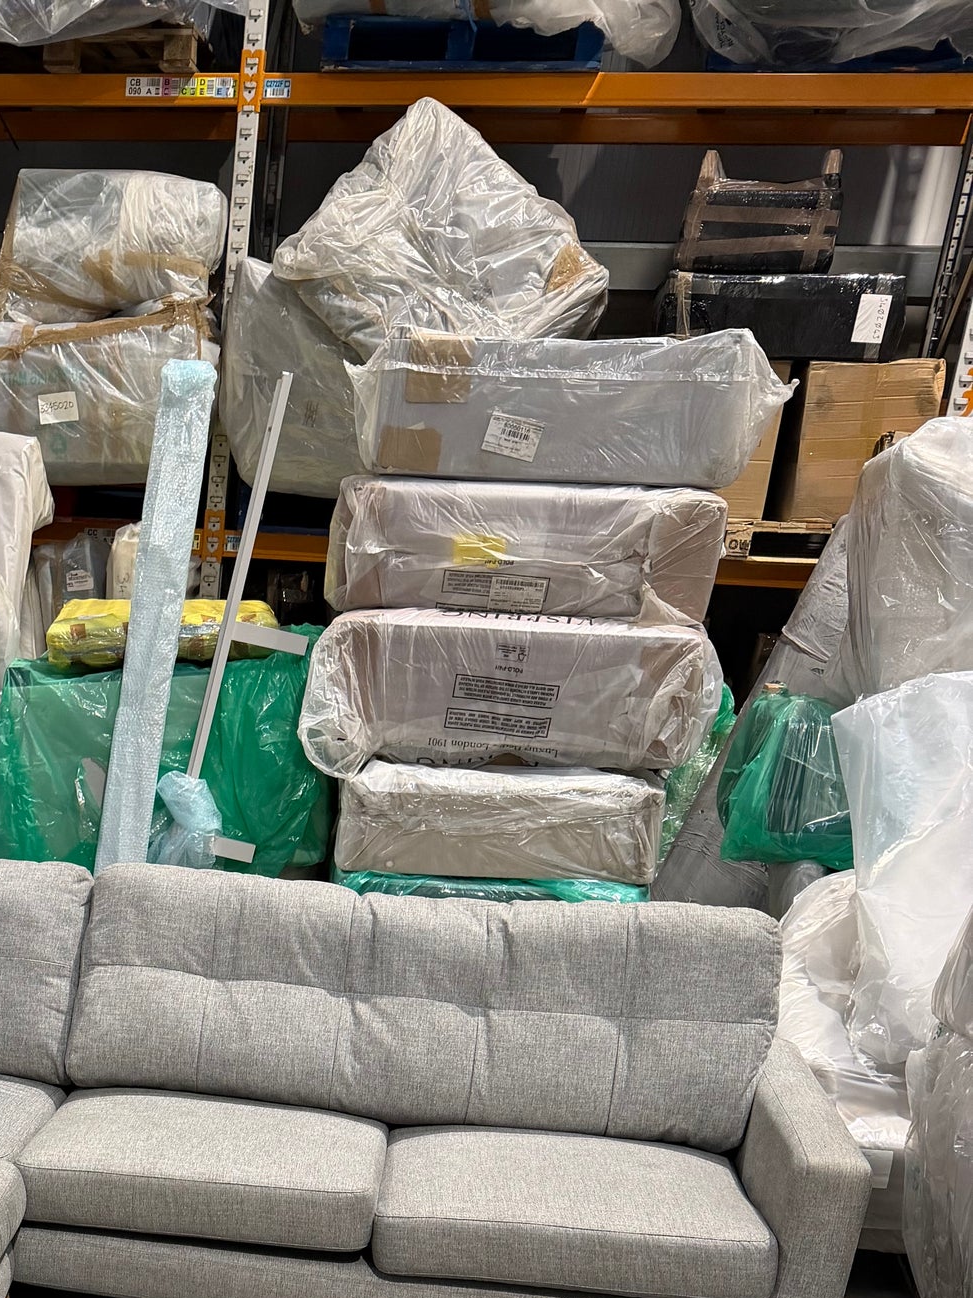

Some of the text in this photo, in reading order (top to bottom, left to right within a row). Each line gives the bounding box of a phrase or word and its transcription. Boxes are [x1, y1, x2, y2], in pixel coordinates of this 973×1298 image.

[130, 78, 141, 86] CB
[128, 87, 142, 95] 090
[427, 737, 447, 747] 1901
[451, 739, 490, 751] London
